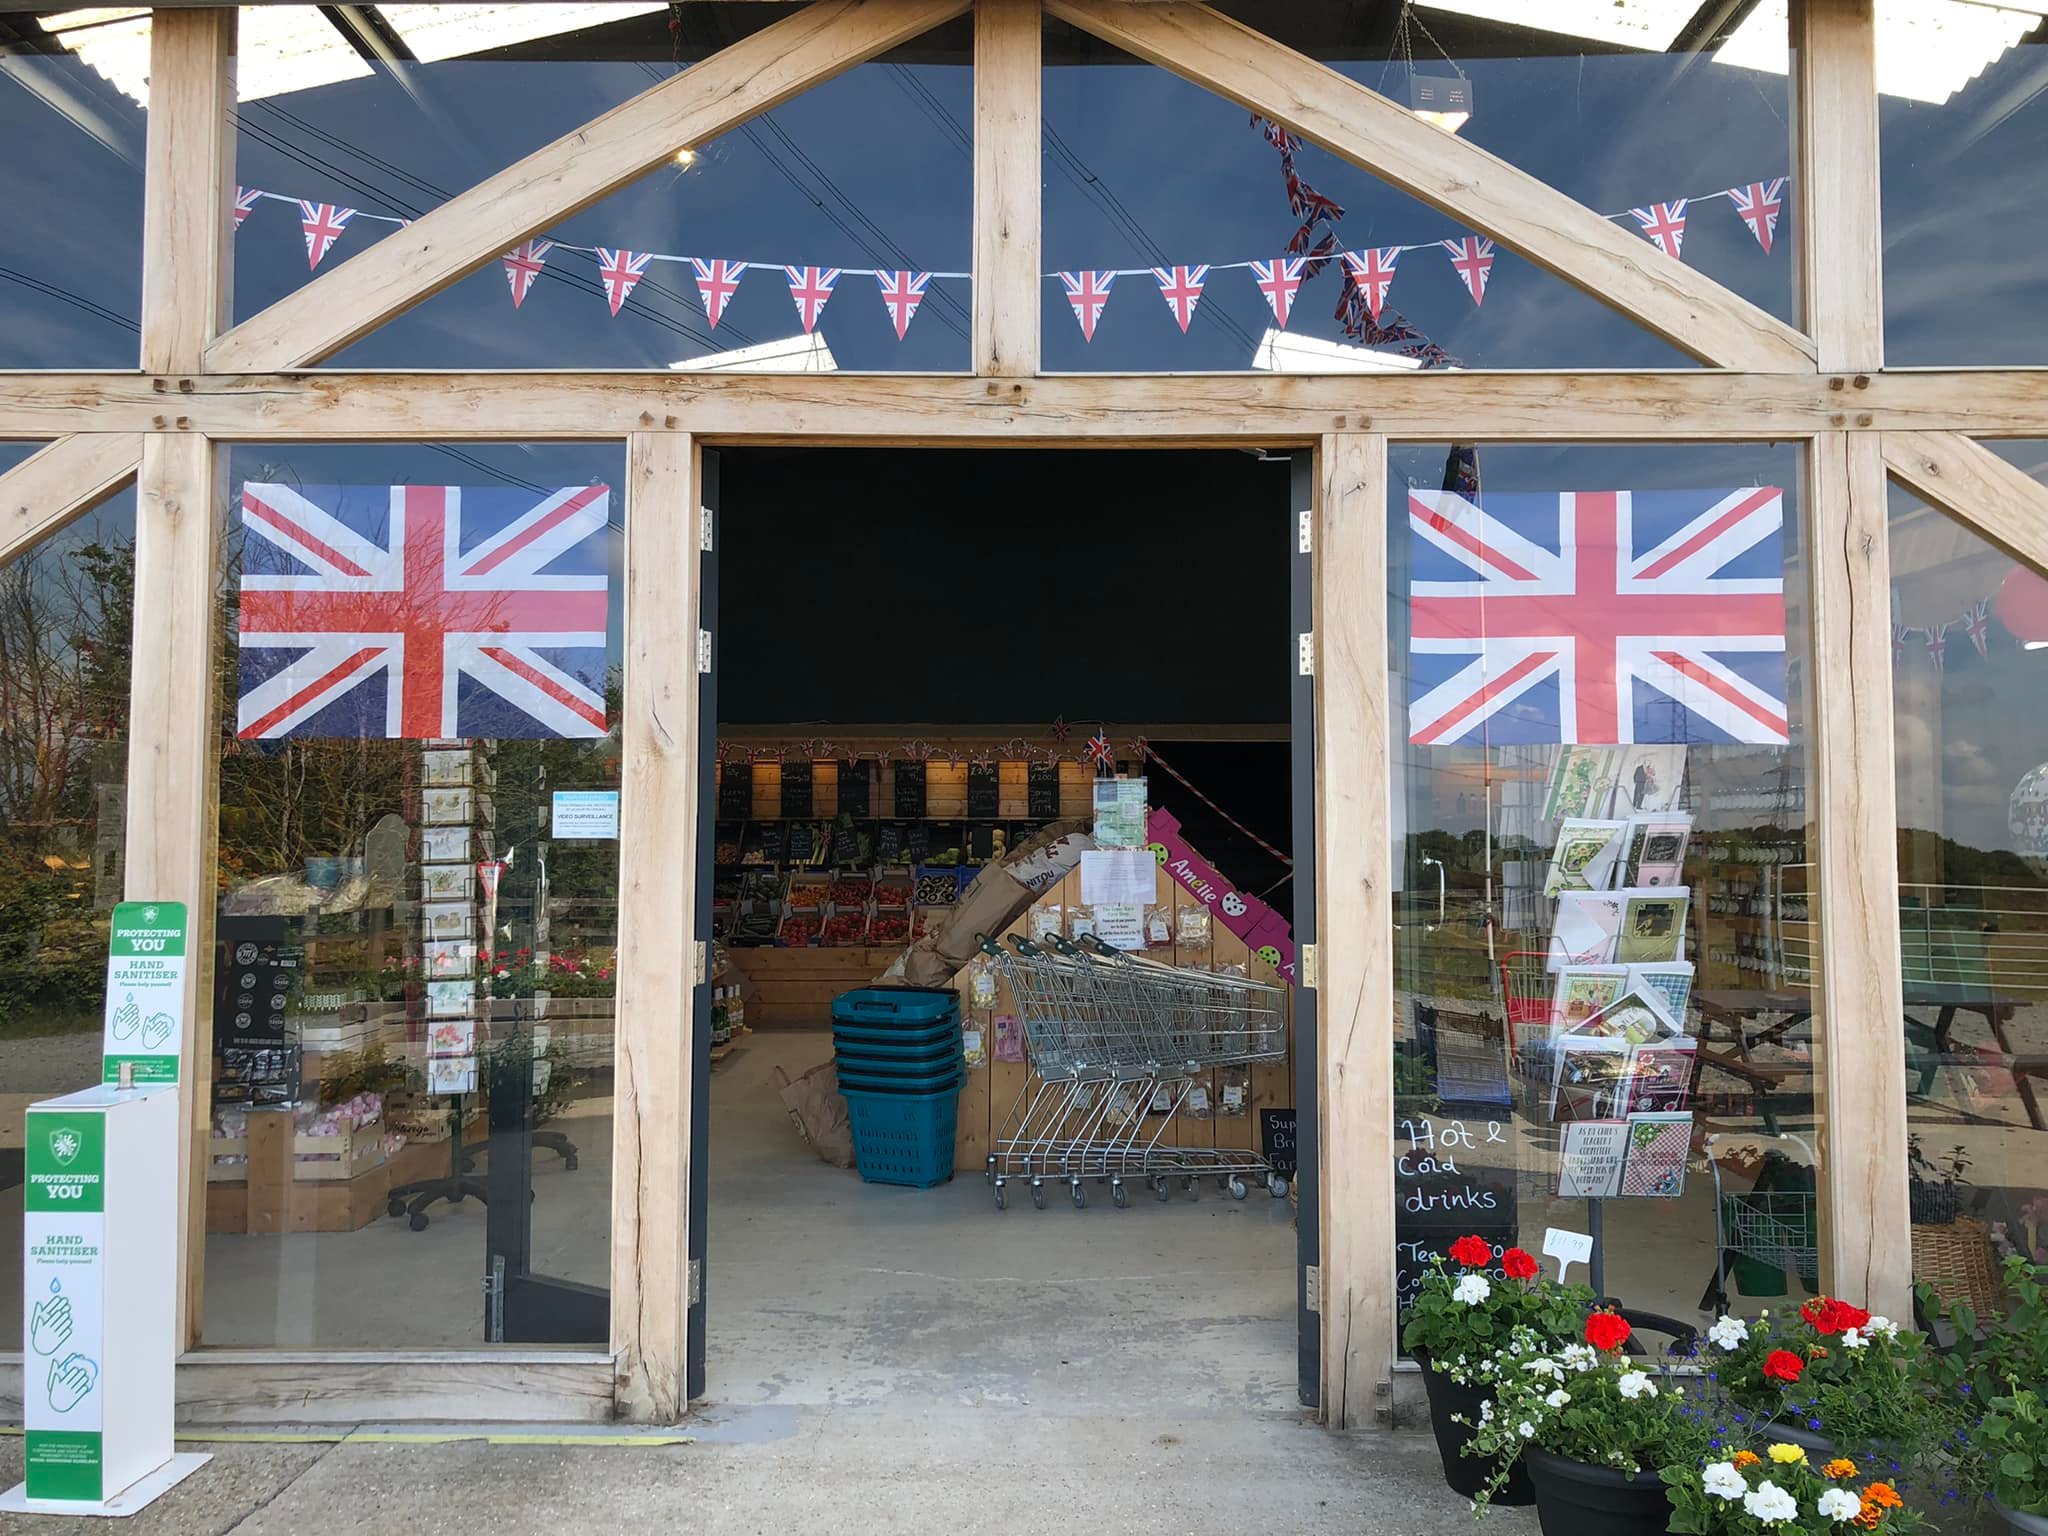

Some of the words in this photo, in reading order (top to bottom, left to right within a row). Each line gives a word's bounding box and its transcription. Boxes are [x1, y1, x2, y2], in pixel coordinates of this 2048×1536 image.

[116, 929, 181, 938] PROTECTING
[131, 939, 166, 951] YOU
[129, 960, 165, 969] HAND
[113, 970, 178, 979] SANITISER
[1401, 1119, 1476, 1150] Hot
[31, 1174, 99, 1183] PROTECTING
[46, 1185, 83, 1199] YOU
[1406, 1185, 1497, 1212] drinks
[46, 1235, 83, 1245] HAND
[30, 1246, 98, 1256] SANITISER
